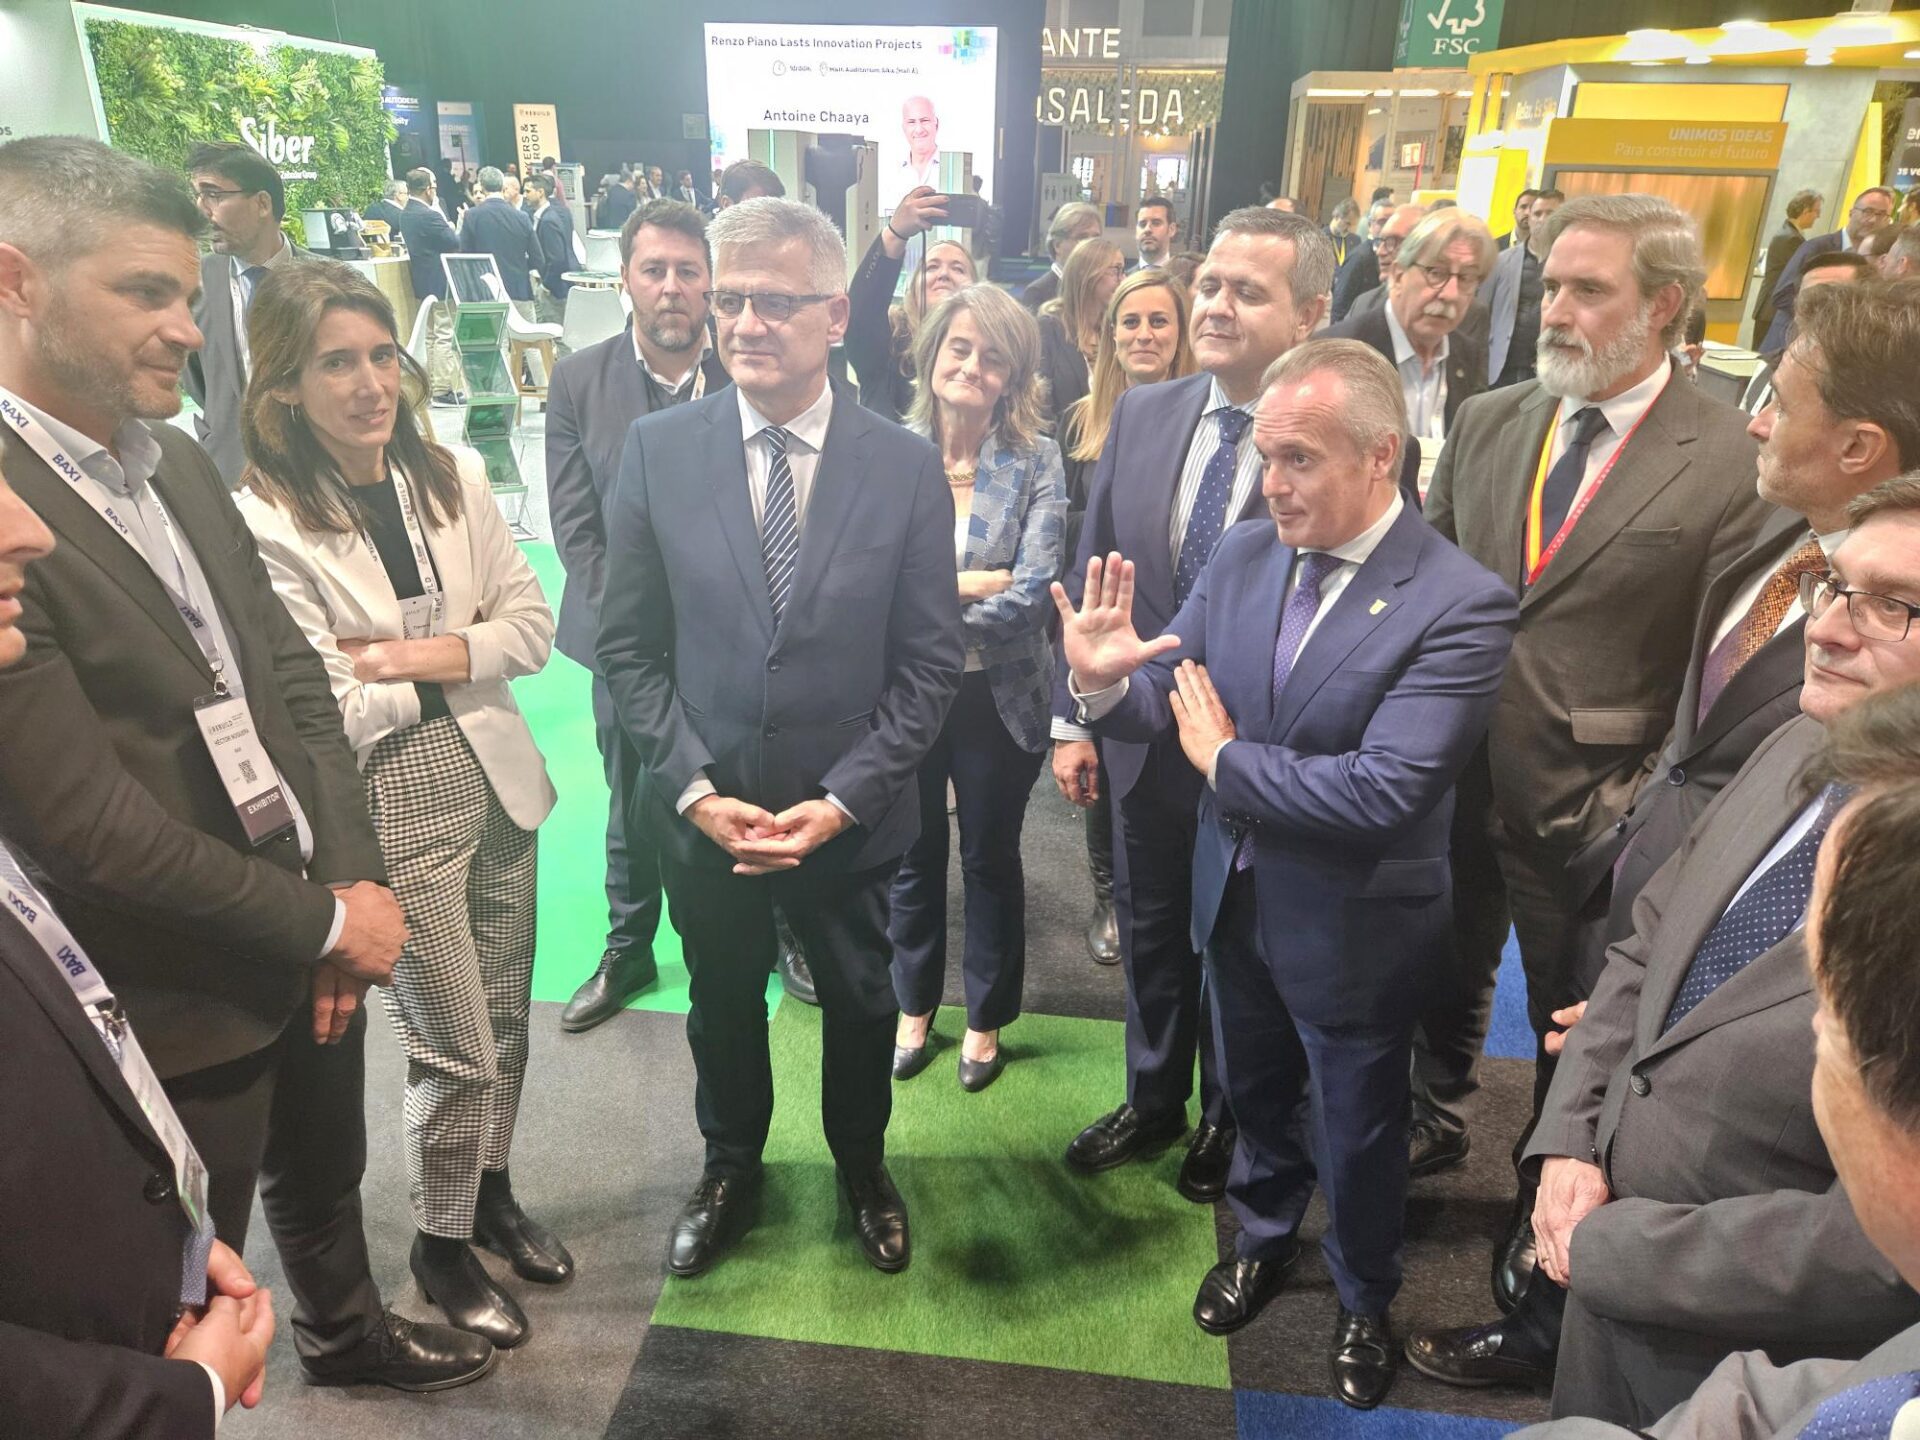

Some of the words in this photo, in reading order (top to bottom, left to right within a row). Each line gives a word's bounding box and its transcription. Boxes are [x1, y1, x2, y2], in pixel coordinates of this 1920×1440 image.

[711, 36, 744, 46] Renzo
[747, 37, 778, 47] Piano
[780, 37, 810, 47] Lasts
[813, 38, 873, 49] Innovation
[875, 39, 922, 51] Projects
[1042, 28, 1121, 58] ANTE
[1432, 38, 1480, 55] FSC
[520, 123, 529, 132] &
[763, 109, 815, 122] Antoine
[820, 111, 869, 124] Chaaya
[240, 117, 315, 164] Siber
[530, 124, 542, 160] ROOM
[1668, 128, 1727, 141] UNIMOS
[1730, 129, 1774, 143] IDEAS
[1615, 142, 1644, 157] Para
[1647, 144, 1708, 159] construir
[1725, 145, 1769, 160] futuro
[0, 400, 29, 428] BAXI
[52, 453, 82, 482] BAXI
[398, 482, 414, 522] REBUILD
[104, 507, 128, 534] BAXI
[180, 606, 204, 629] BAXI
[247, 792, 281, 815] EXHIBITOR
[8, 889, 37, 924] BAXI
[56, 945, 86, 978] BAXI
